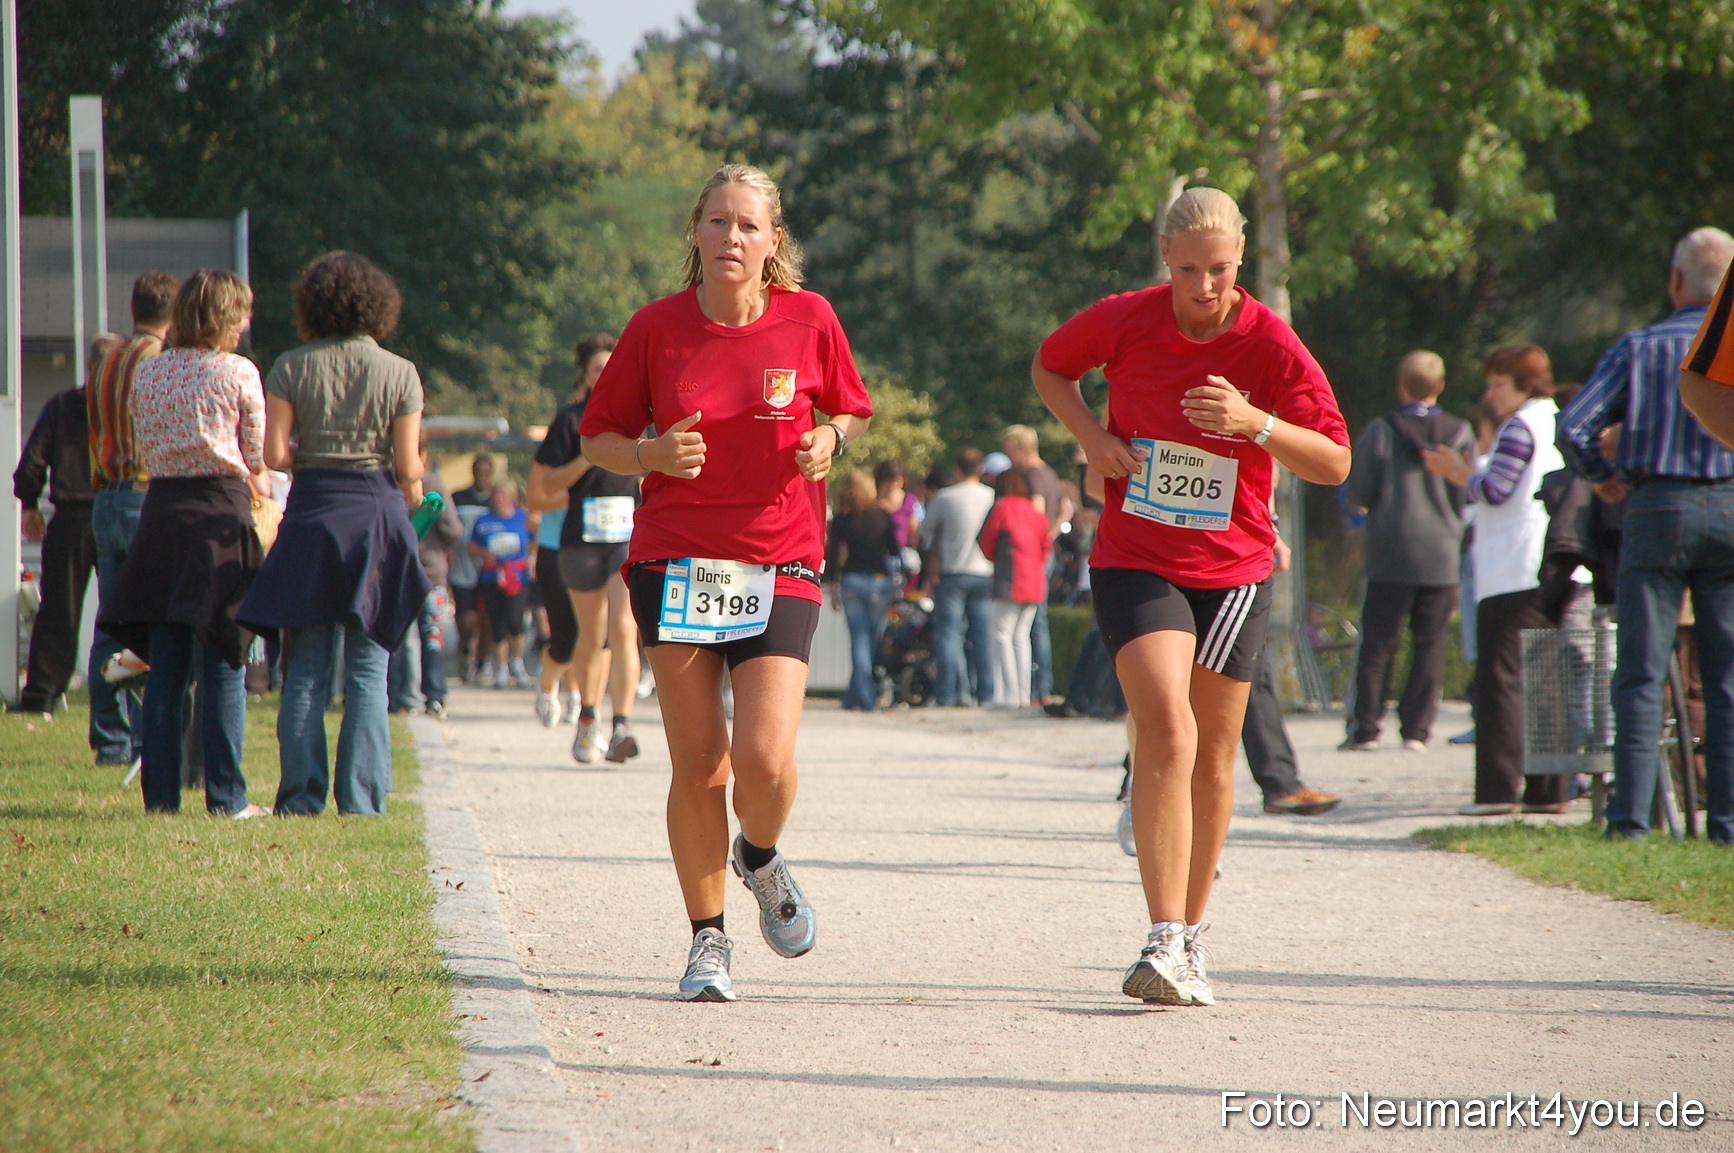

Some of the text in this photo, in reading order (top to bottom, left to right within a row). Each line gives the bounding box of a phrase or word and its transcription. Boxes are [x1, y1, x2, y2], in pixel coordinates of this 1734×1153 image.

[1159, 448, 1204, 468] Marion
[1157, 473, 1223, 500] 3205
[696, 566, 731, 585] Doris
[671, 587, 678, 600] D
[695, 592, 760, 616] 3198
